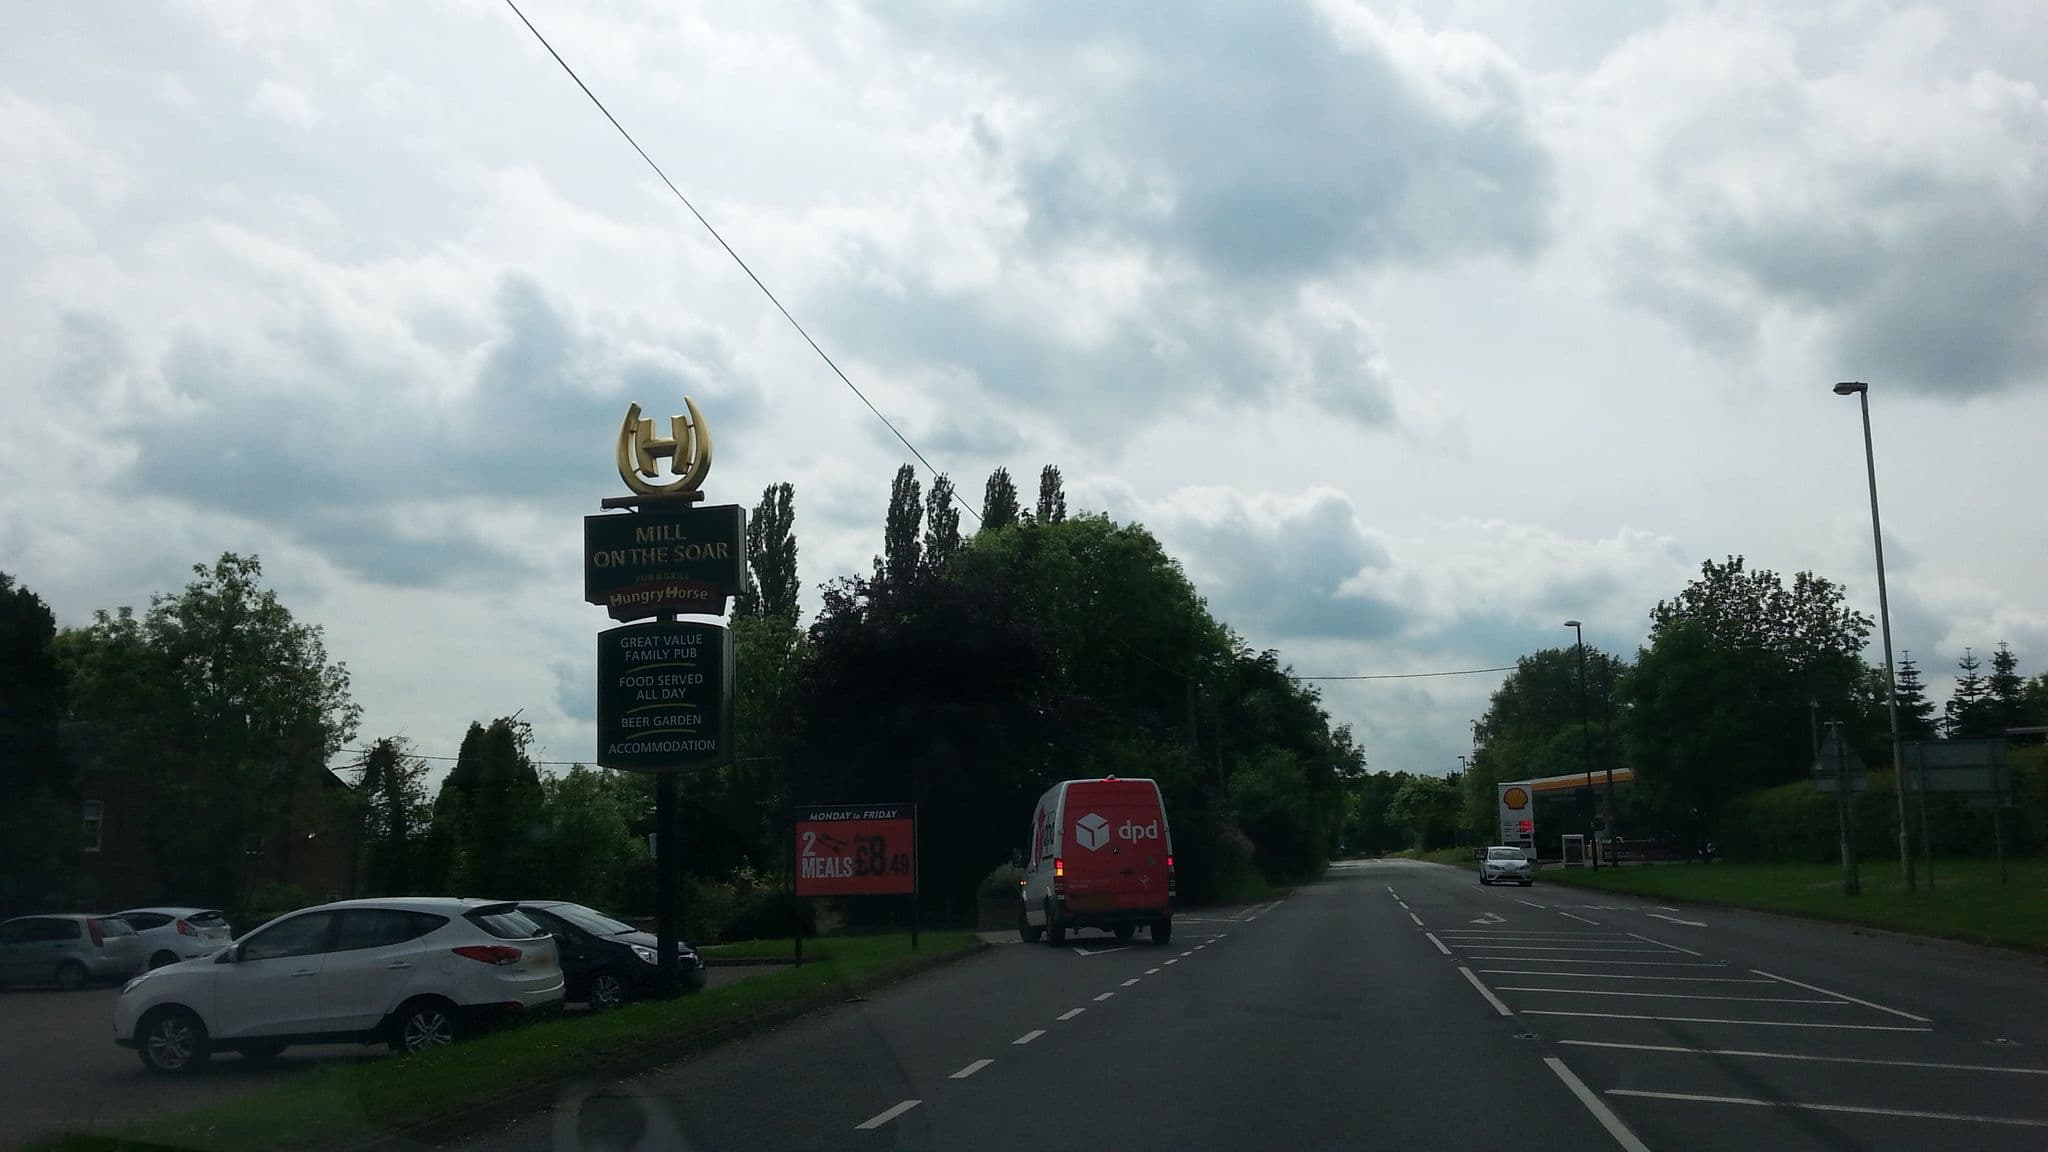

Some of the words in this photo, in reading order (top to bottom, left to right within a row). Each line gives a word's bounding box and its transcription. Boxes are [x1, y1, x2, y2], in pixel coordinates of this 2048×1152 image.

[635, 524, 687, 544] MILL
[593, 549, 625, 567] ON
[628, 546, 668, 565] THE
[673, 543, 729, 561] SOAR
[620, 636, 659, 648] GREAT
[663, 633, 703, 645] VALUE
[625, 648, 670, 661] FAMILY
[674, 647, 697, 659] PUB
[619, 675, 654, 687] FOOD
[658, 673, 704, 686] SERVED
[636, 689, 658, 700] ALL
[662, 688, 687, 699] DAY
[621, 716, 649, 728] BEER
[653, 714, 702, 726] GARDEN
[608, 740, 715, 754] ACCOMMODATION
[809, 812, 852, 820] MONDAY
[853, 812, 861, 820] to
[863, 810, 898, 819] FRIDAY
[1118, 820, 1158, 843] dpd
[802, 832, 816, 857] 2
[801, 856, 853, 879] MEALS
